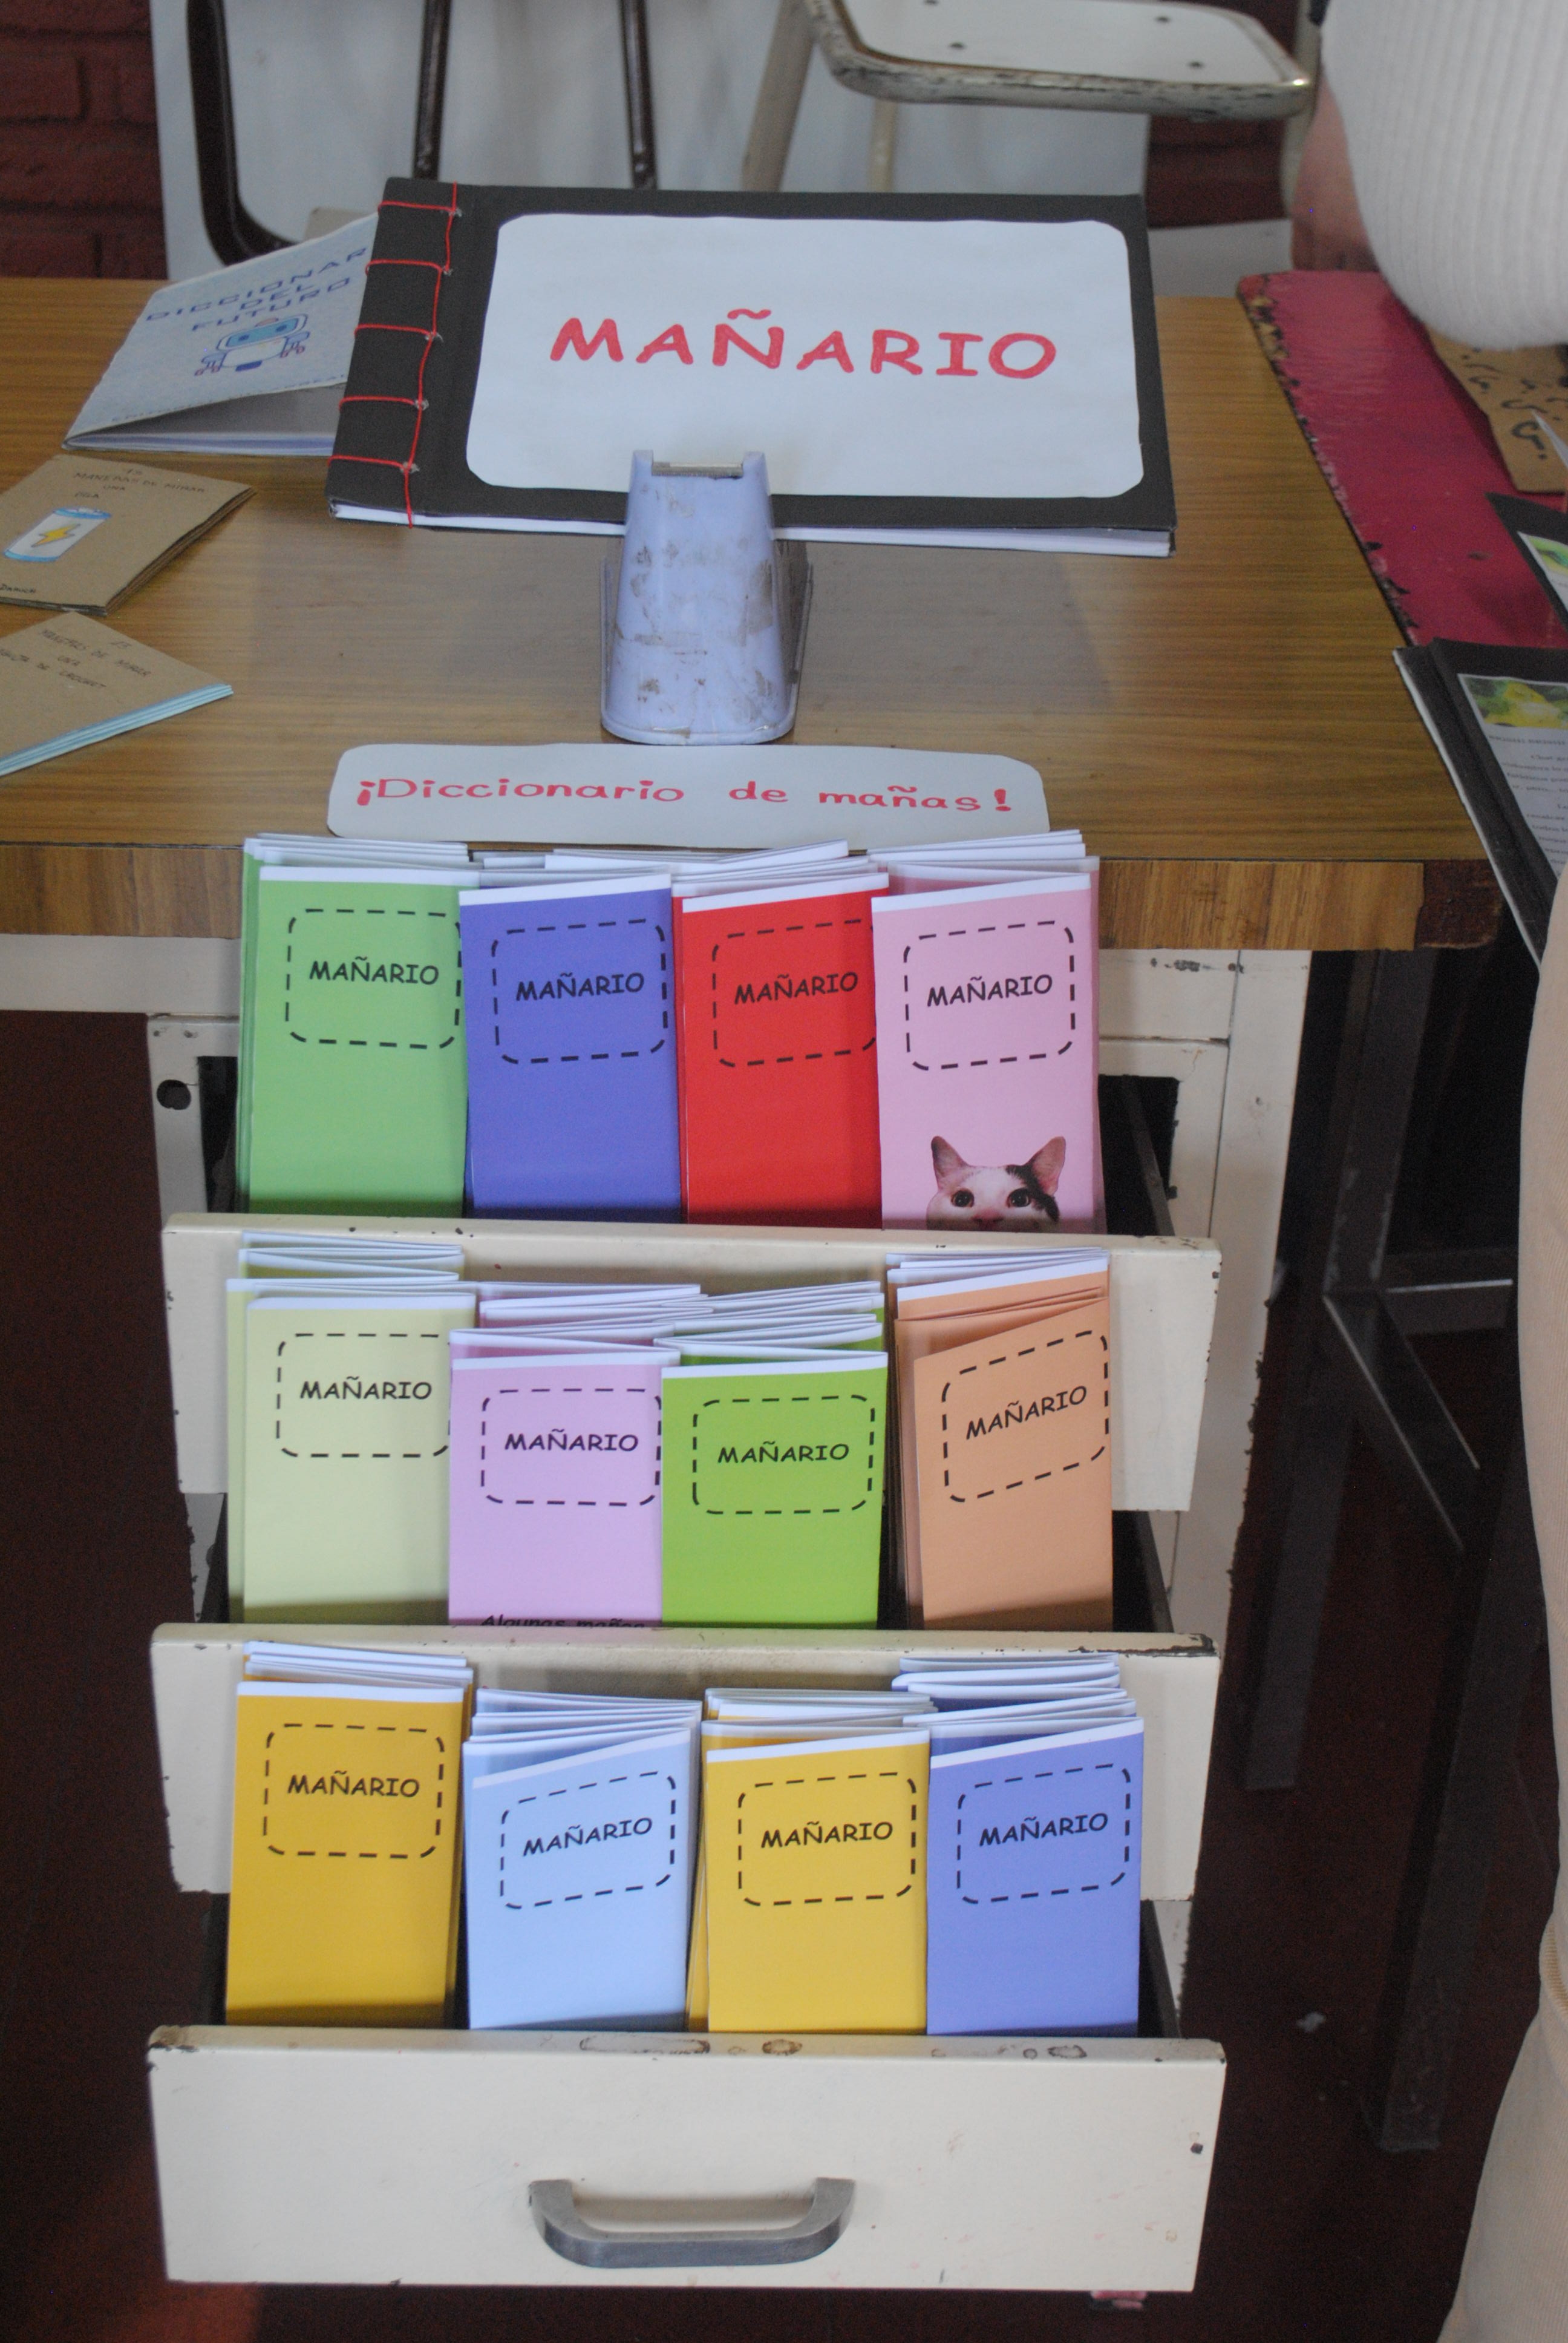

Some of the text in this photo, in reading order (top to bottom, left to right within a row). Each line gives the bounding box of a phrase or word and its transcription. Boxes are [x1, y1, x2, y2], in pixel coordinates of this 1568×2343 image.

[191, 277, 350, 331] FUTURO
[240, 285, 314, 310] DEL
[549, 307, 1057, 379] MAÑARIO
[357, 778, 684, 806] ¡Diccionario
[729, 780, 786, 802] de
[309, 955, 440, 986] MAÑARIO
[515, 971, 645, 1002] MAÑARIO
[734, 971, 859, 1005] MAÑARIO
[926, 974, 1053, 1008] MAÑARIO
[299, 1375, 433, 1400] MAÑARIO
[965, 1385, 1088, 1441] MAÑARIO
[504, 1428, 639, 1452] MAÑARIO
[717, 1440, 850, 1464] MAÑARIO
[287, 1769, 420, 1798] MAÑARIO
[522, 1817, 653, 1857] MAÑARIO
[760, 1820, 893, 1849] MAÑARIO
[978, 1812, 1109, 1847] MAÑARIO
